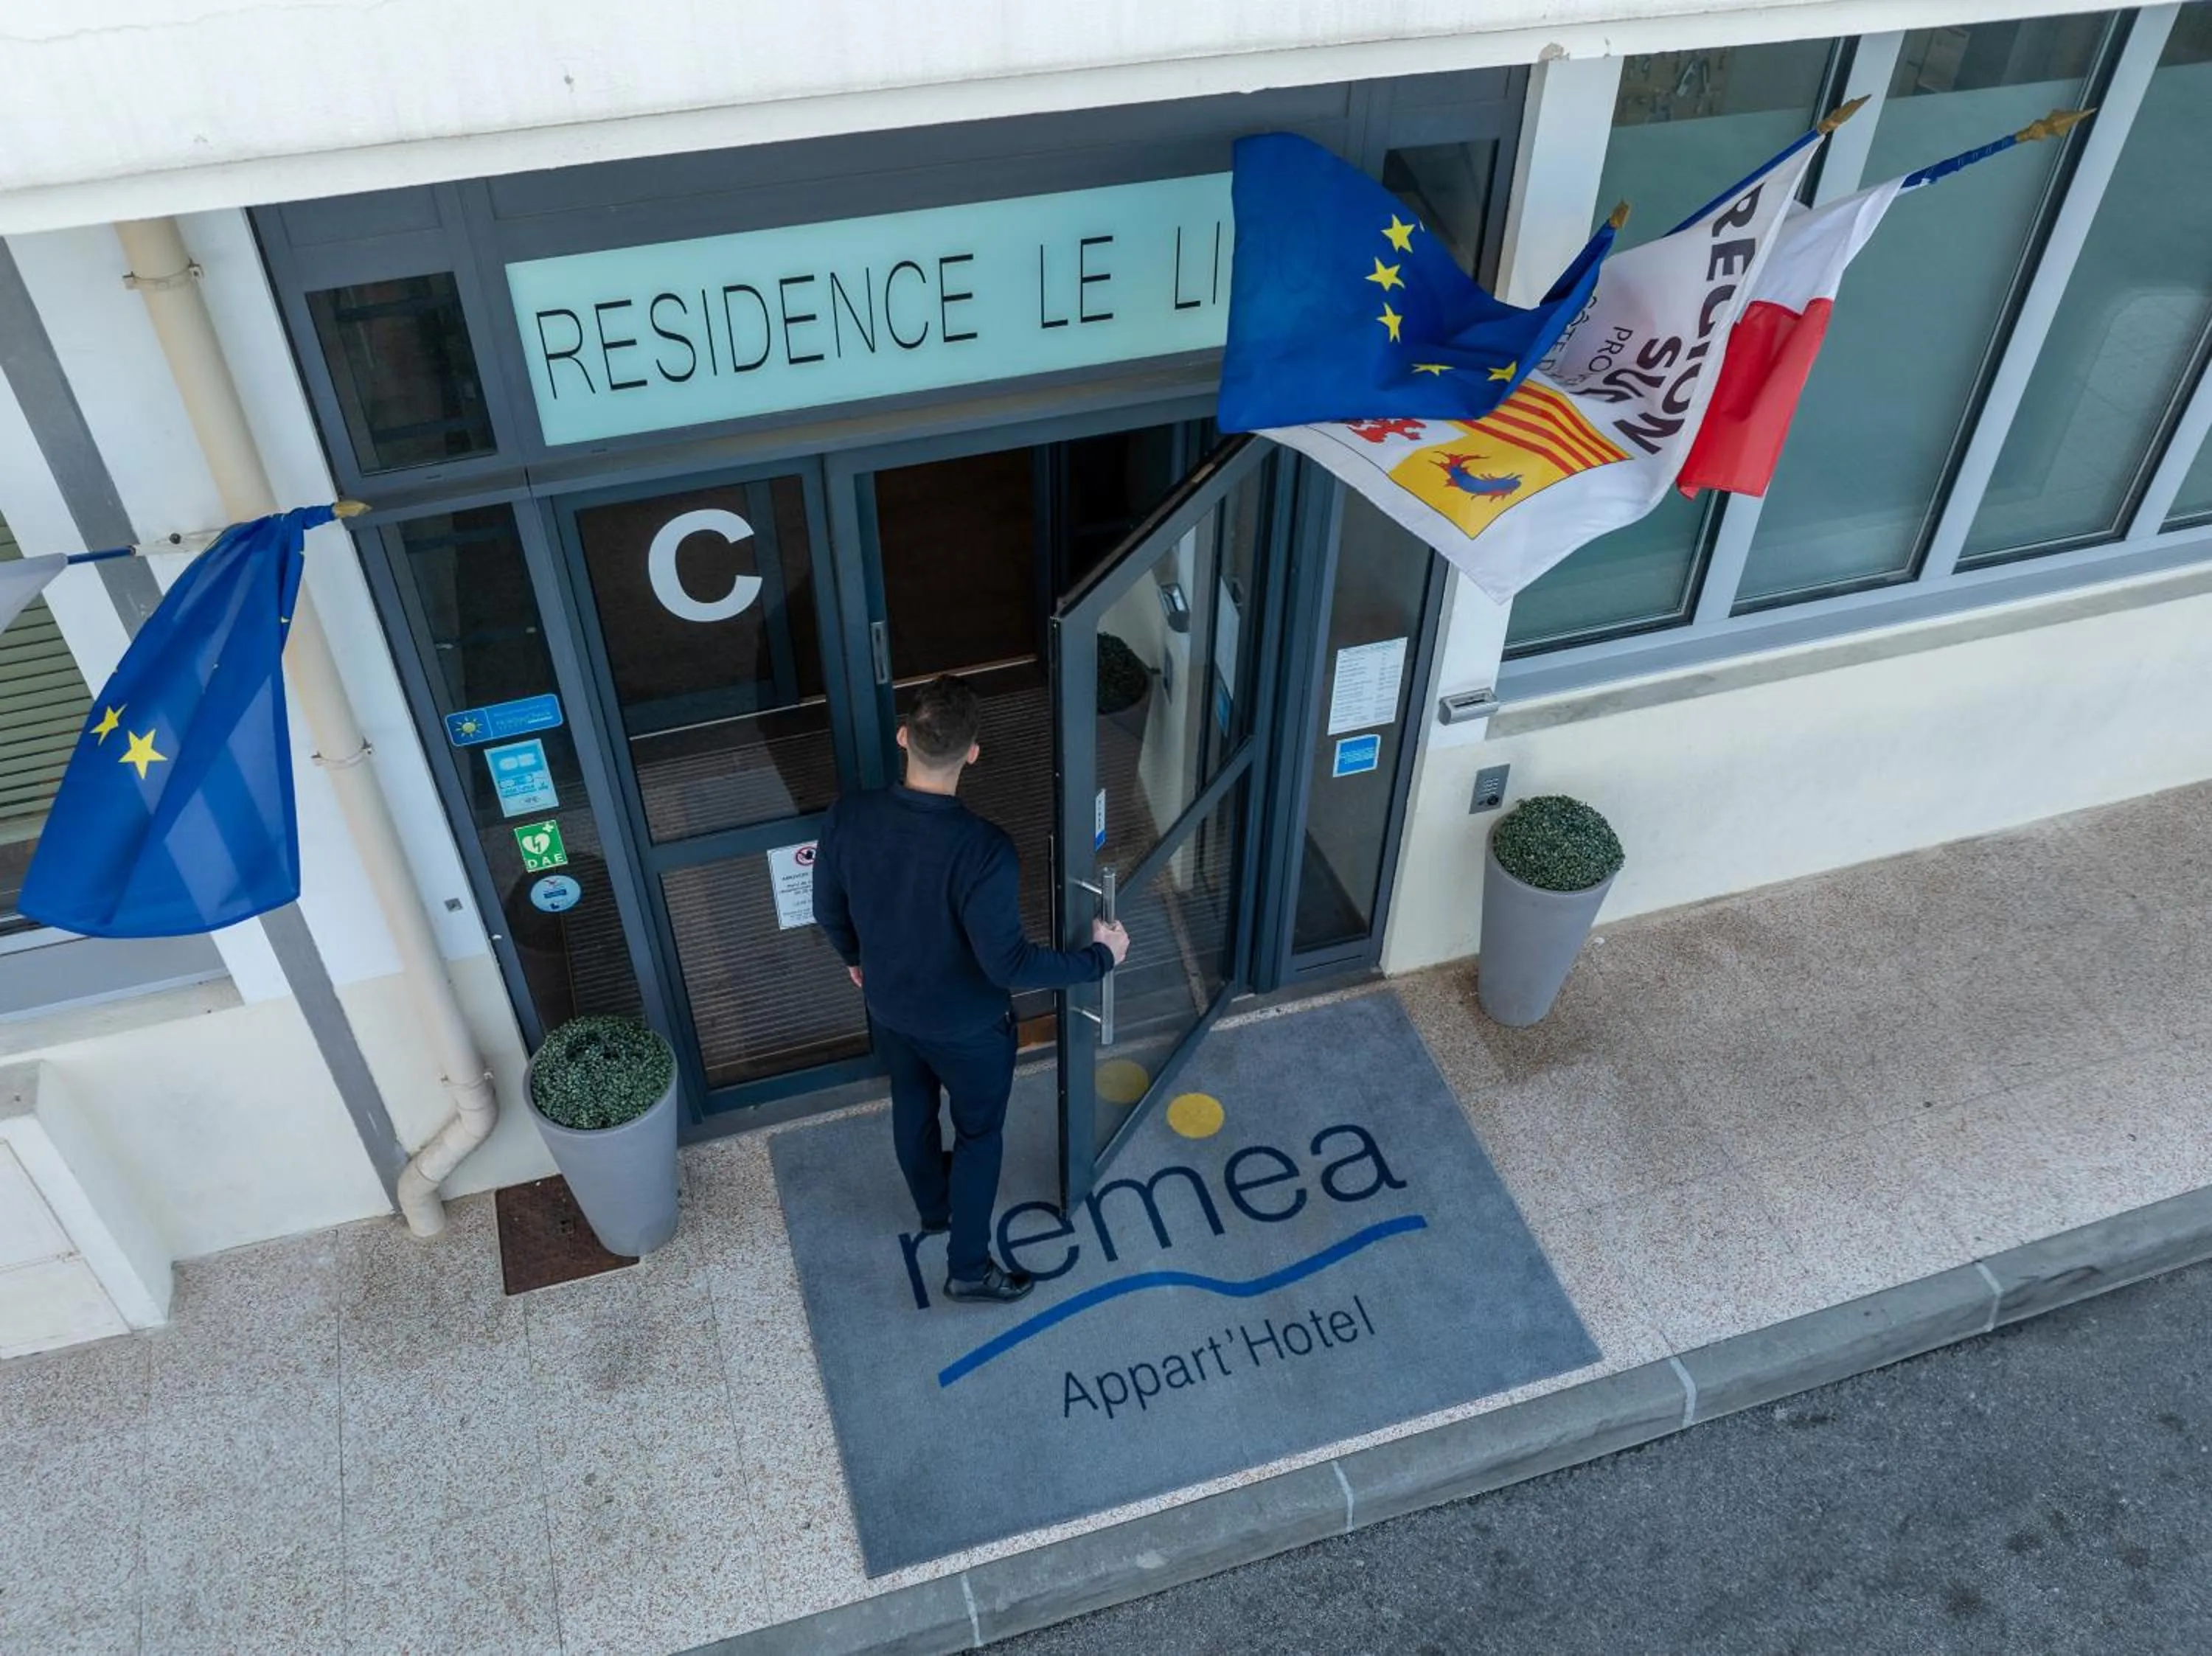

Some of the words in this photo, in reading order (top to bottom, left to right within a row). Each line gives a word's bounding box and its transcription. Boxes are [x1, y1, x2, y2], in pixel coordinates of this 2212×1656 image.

[536, 254, 978, 400] RESIDENCE
[1040, 235, 1114, 330] LE
[648, 508, 763, 622] C
[526, 853, 564, 869] DAE
[1062, 1294, 1377, 1419] Appart'Hotel
